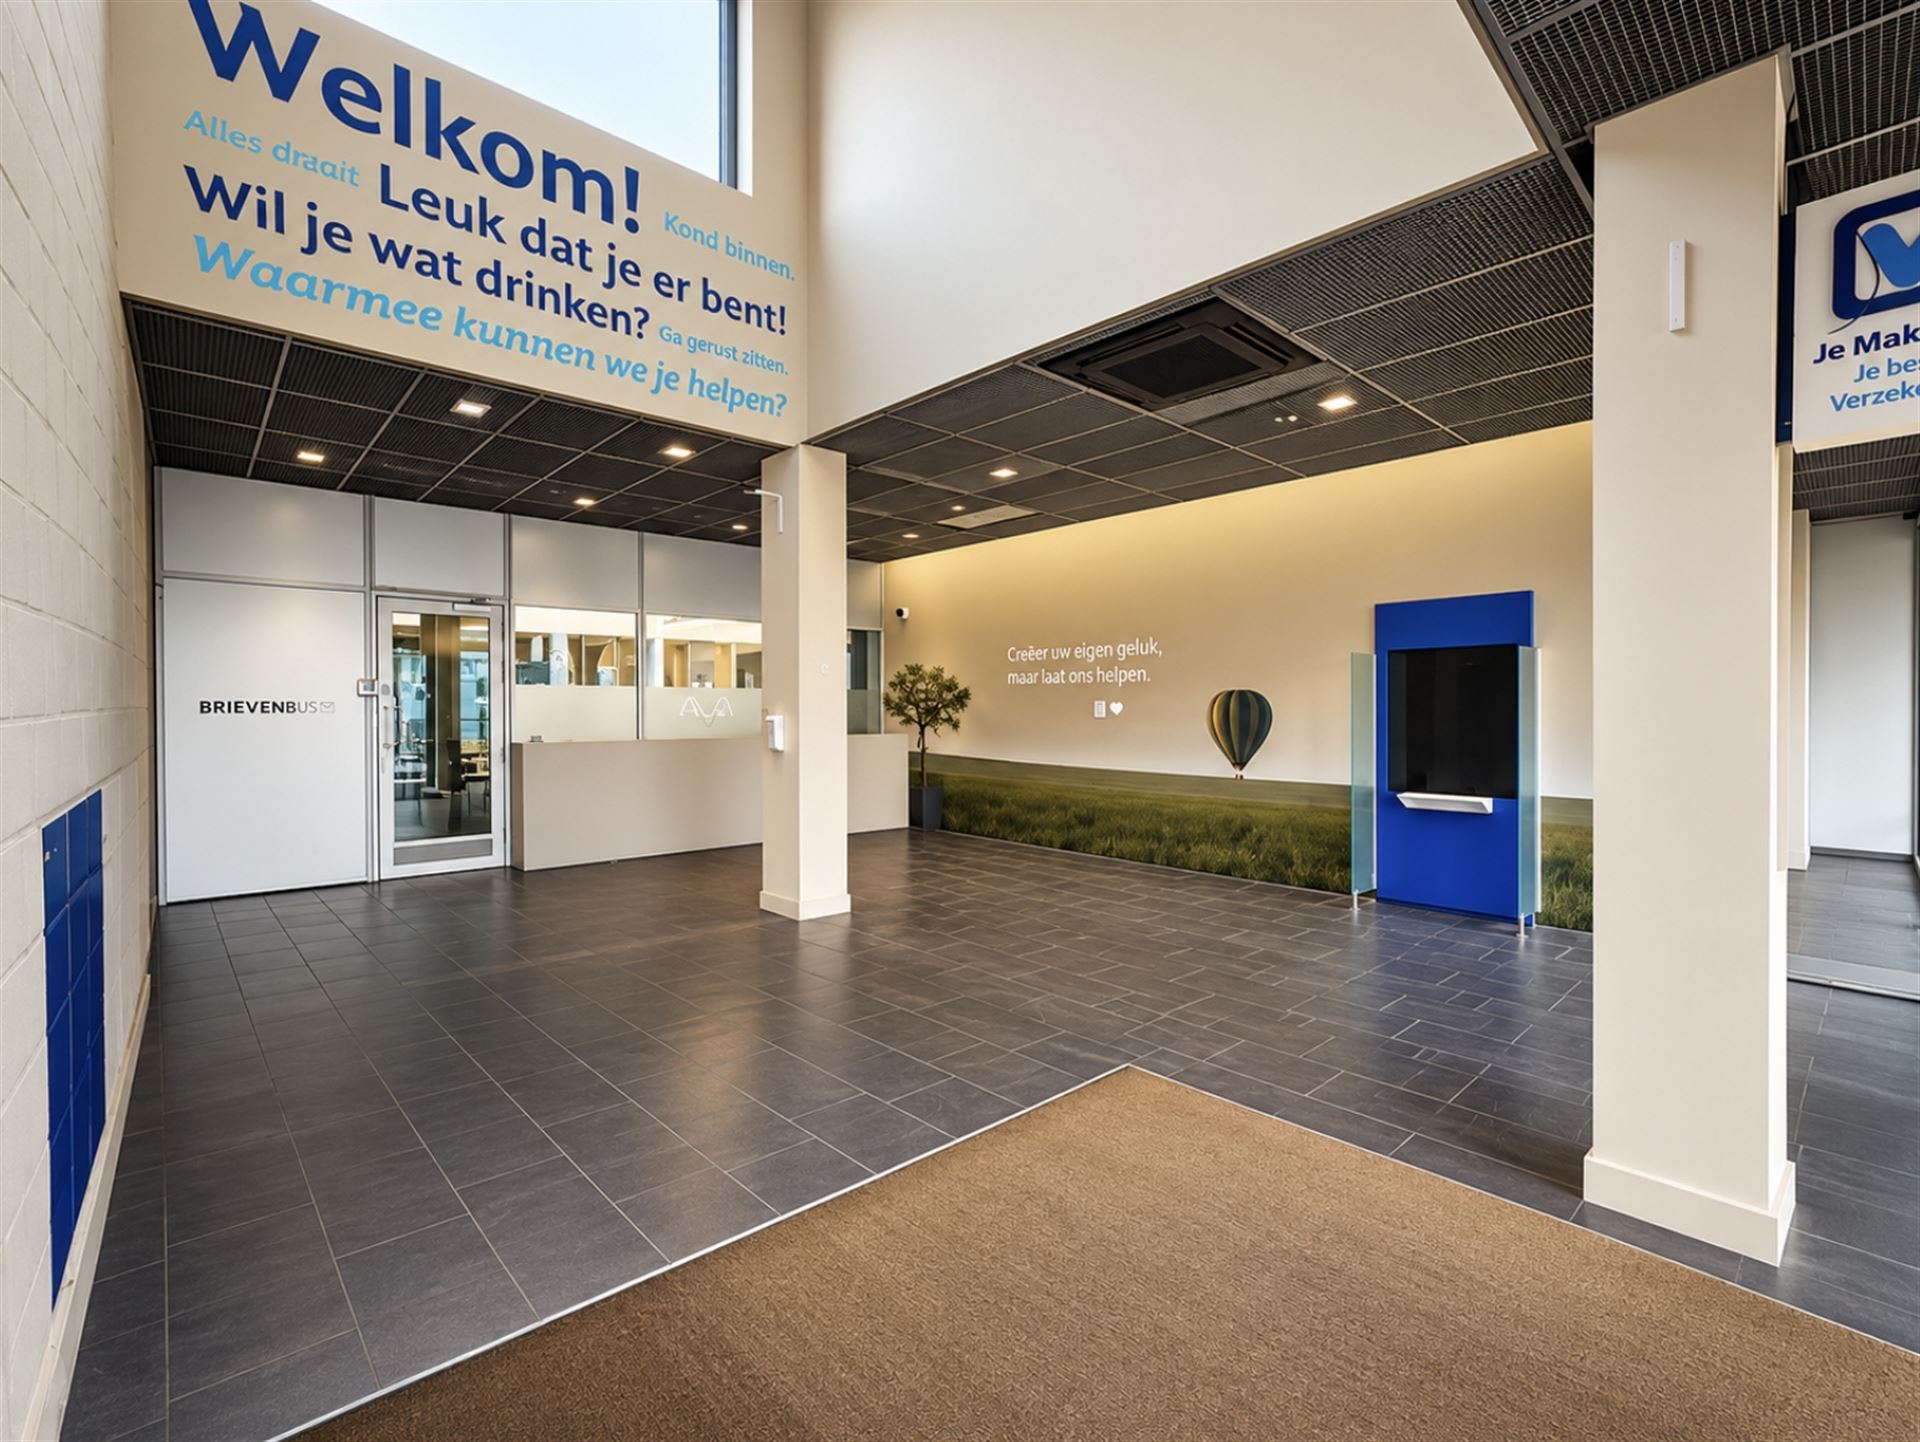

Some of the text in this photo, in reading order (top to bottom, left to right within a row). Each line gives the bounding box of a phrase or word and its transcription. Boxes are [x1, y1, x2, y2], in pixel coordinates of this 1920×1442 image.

[187, 0, 640, 234] Welkom!
[184, 110, 360, 187] Alles draait
[185, 165, 650, 340] Wil je wat drinken?
[380, 164, 786, 336] Leuk dat je er bent!
[664, 210, 795, 281] Kond binnen.
[193, 235, 788, 417] Waarmee kunnen we je helpen?
[658, 325, 789, 376] Ga gerust zitten.
[1813, 343, 1845, 364] Je
[1854, 357, 1920, 384] Je be
[1007, 665, 1151, 687] maar laat ons helpen.
[1051, 647, 1071, 660] uw
[1074, 641, 1113, 663] eigen
[1116, 636, 1162, 661] geluk,
[199, 700, 318, 714] BRIEVENBUS
